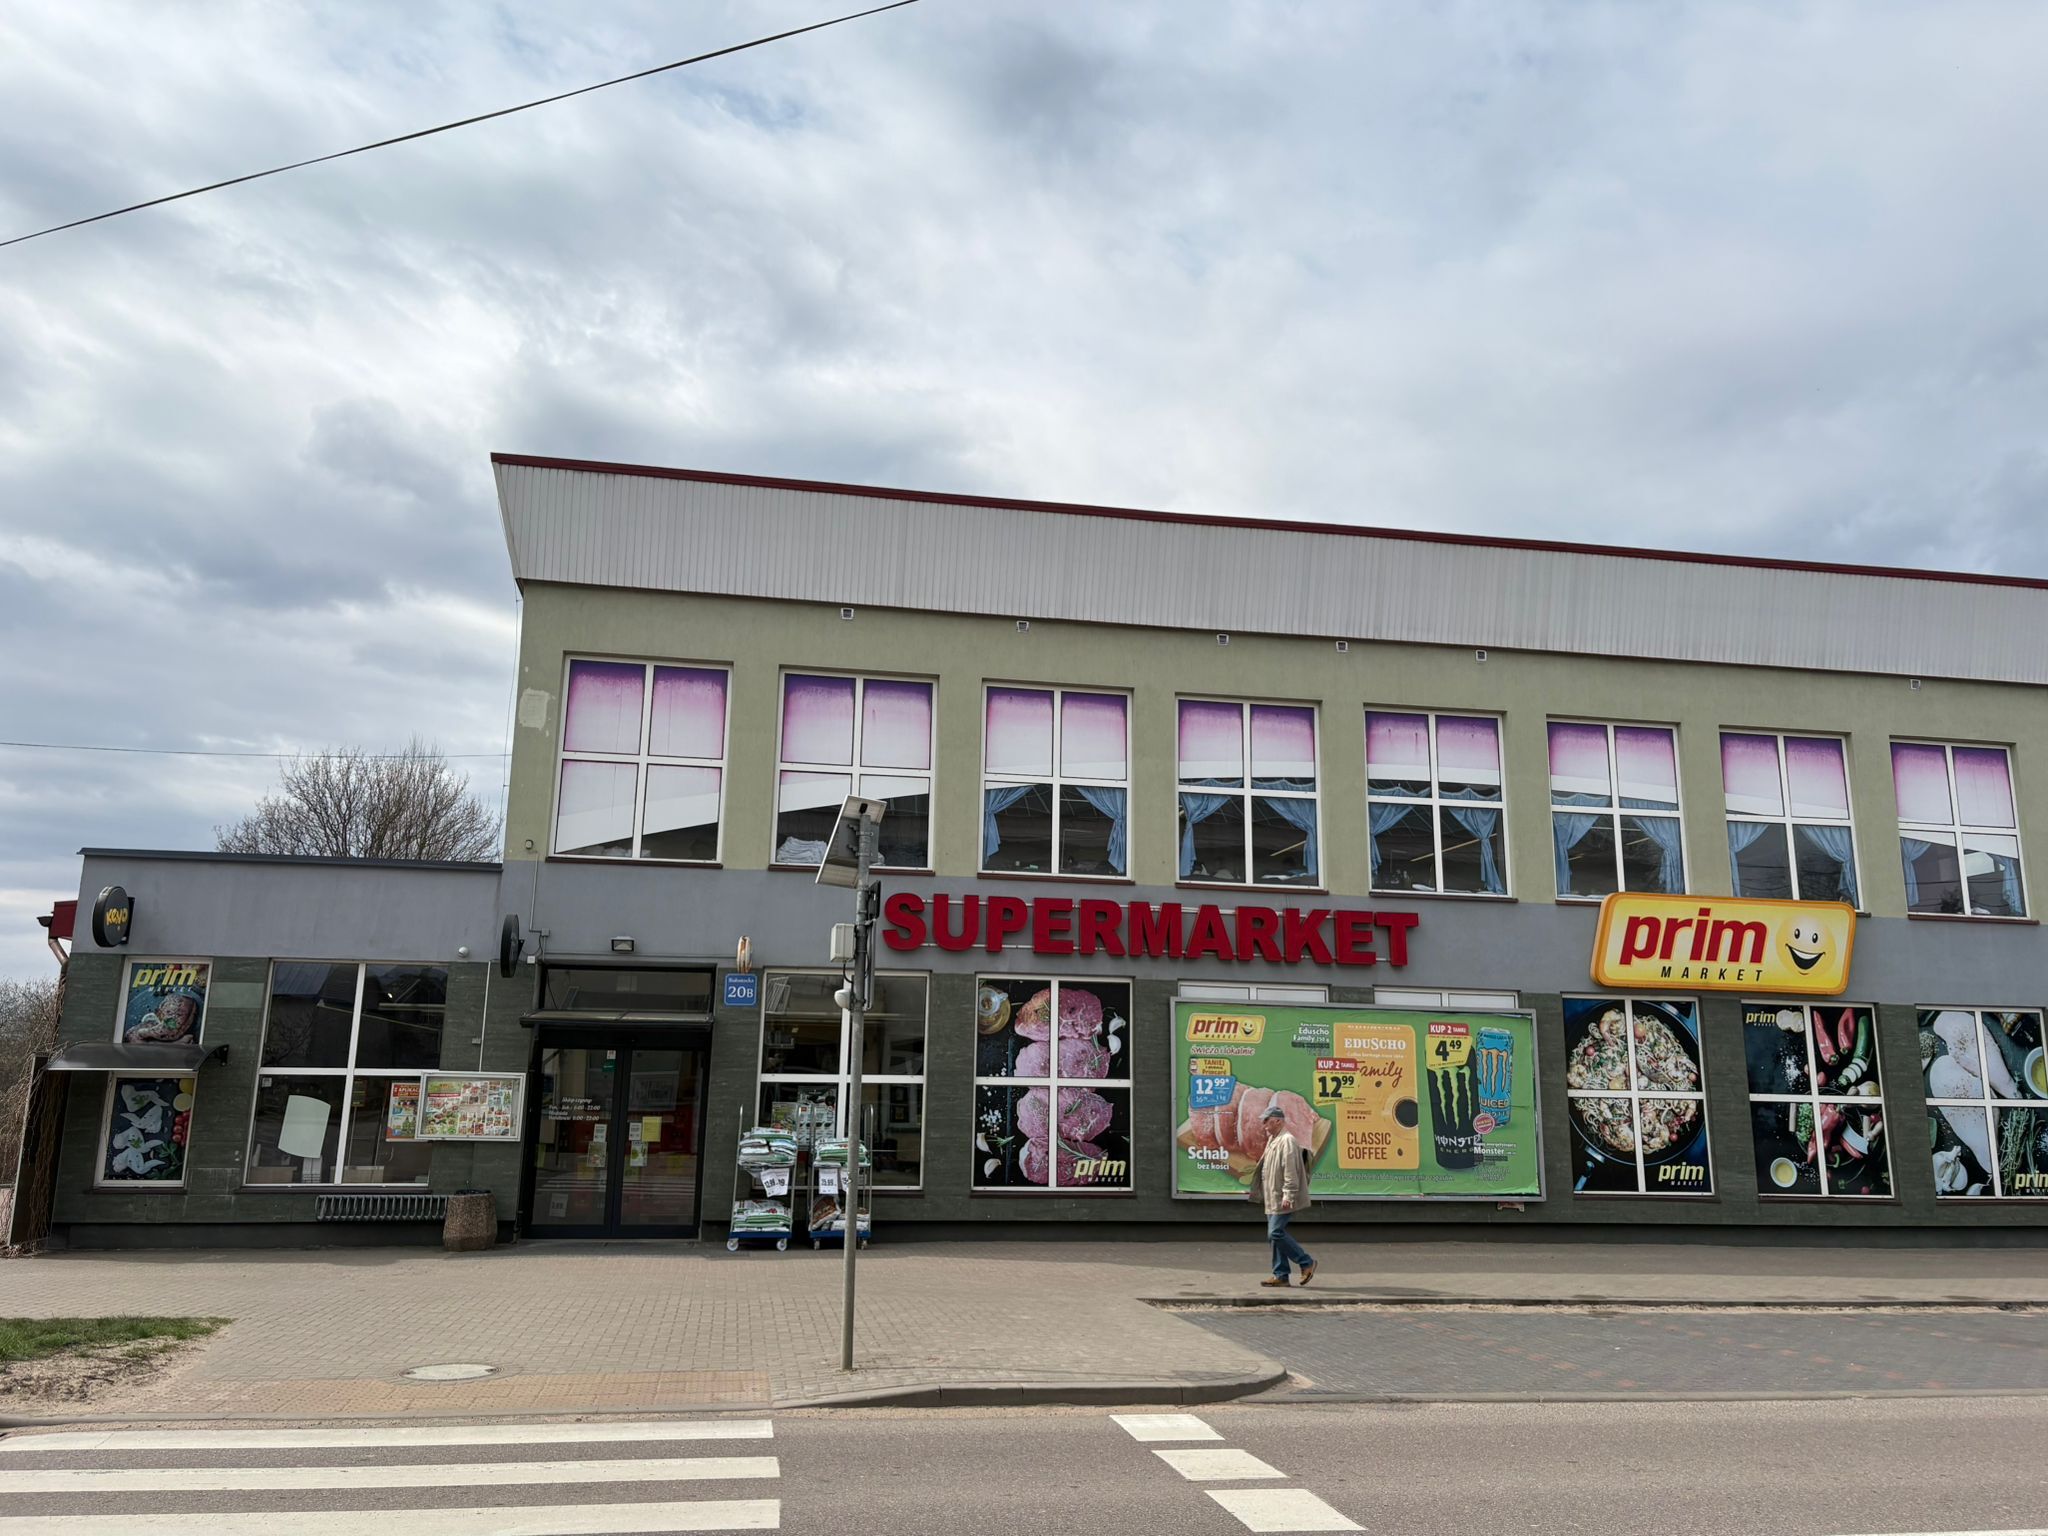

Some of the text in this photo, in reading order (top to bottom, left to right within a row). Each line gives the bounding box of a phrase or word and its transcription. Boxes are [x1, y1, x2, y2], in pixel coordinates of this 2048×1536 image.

[882, 892, 1419, 966] SUPERMARKET
[1619, 907, 1768, 966] prim
[132, 965, 197, 988] prim
[1660, 966, 1763, 982] MARKET
[727, 985, 754, 998] 20B
[1746, 1011, 1775, 1024] prim
[1192, 1017, 1239, 1034] prim
[1299, 1027, 1329, 1035] Eduscho
[1430, 1024, 1446, 1033] KUP
[1447, 1026, 1452, 1034] 2
[1293, 1034, 1315, 1043] Family
[1344, 1038, 1406, 1050] EDUSCHO
[1435, 1040, 1462, 1062] 4 49
[1318, 1060, 1333, 1069] KUP
[1196, 1078, 1213, 1095] 12
[1318, 1075, 1355, 1098] 12 99
[1347, 1132, 1391, 1145] CLASSIC
[1187, 1146, 1229, 1160] Schab
[1348, 1147, 1387, 1160] COFFEE
[1473, 1147, 1504, 1155] Monster
[1074, 1156, 1126, 1178] prim
[1658, 1161, 1704, 1181] prim
